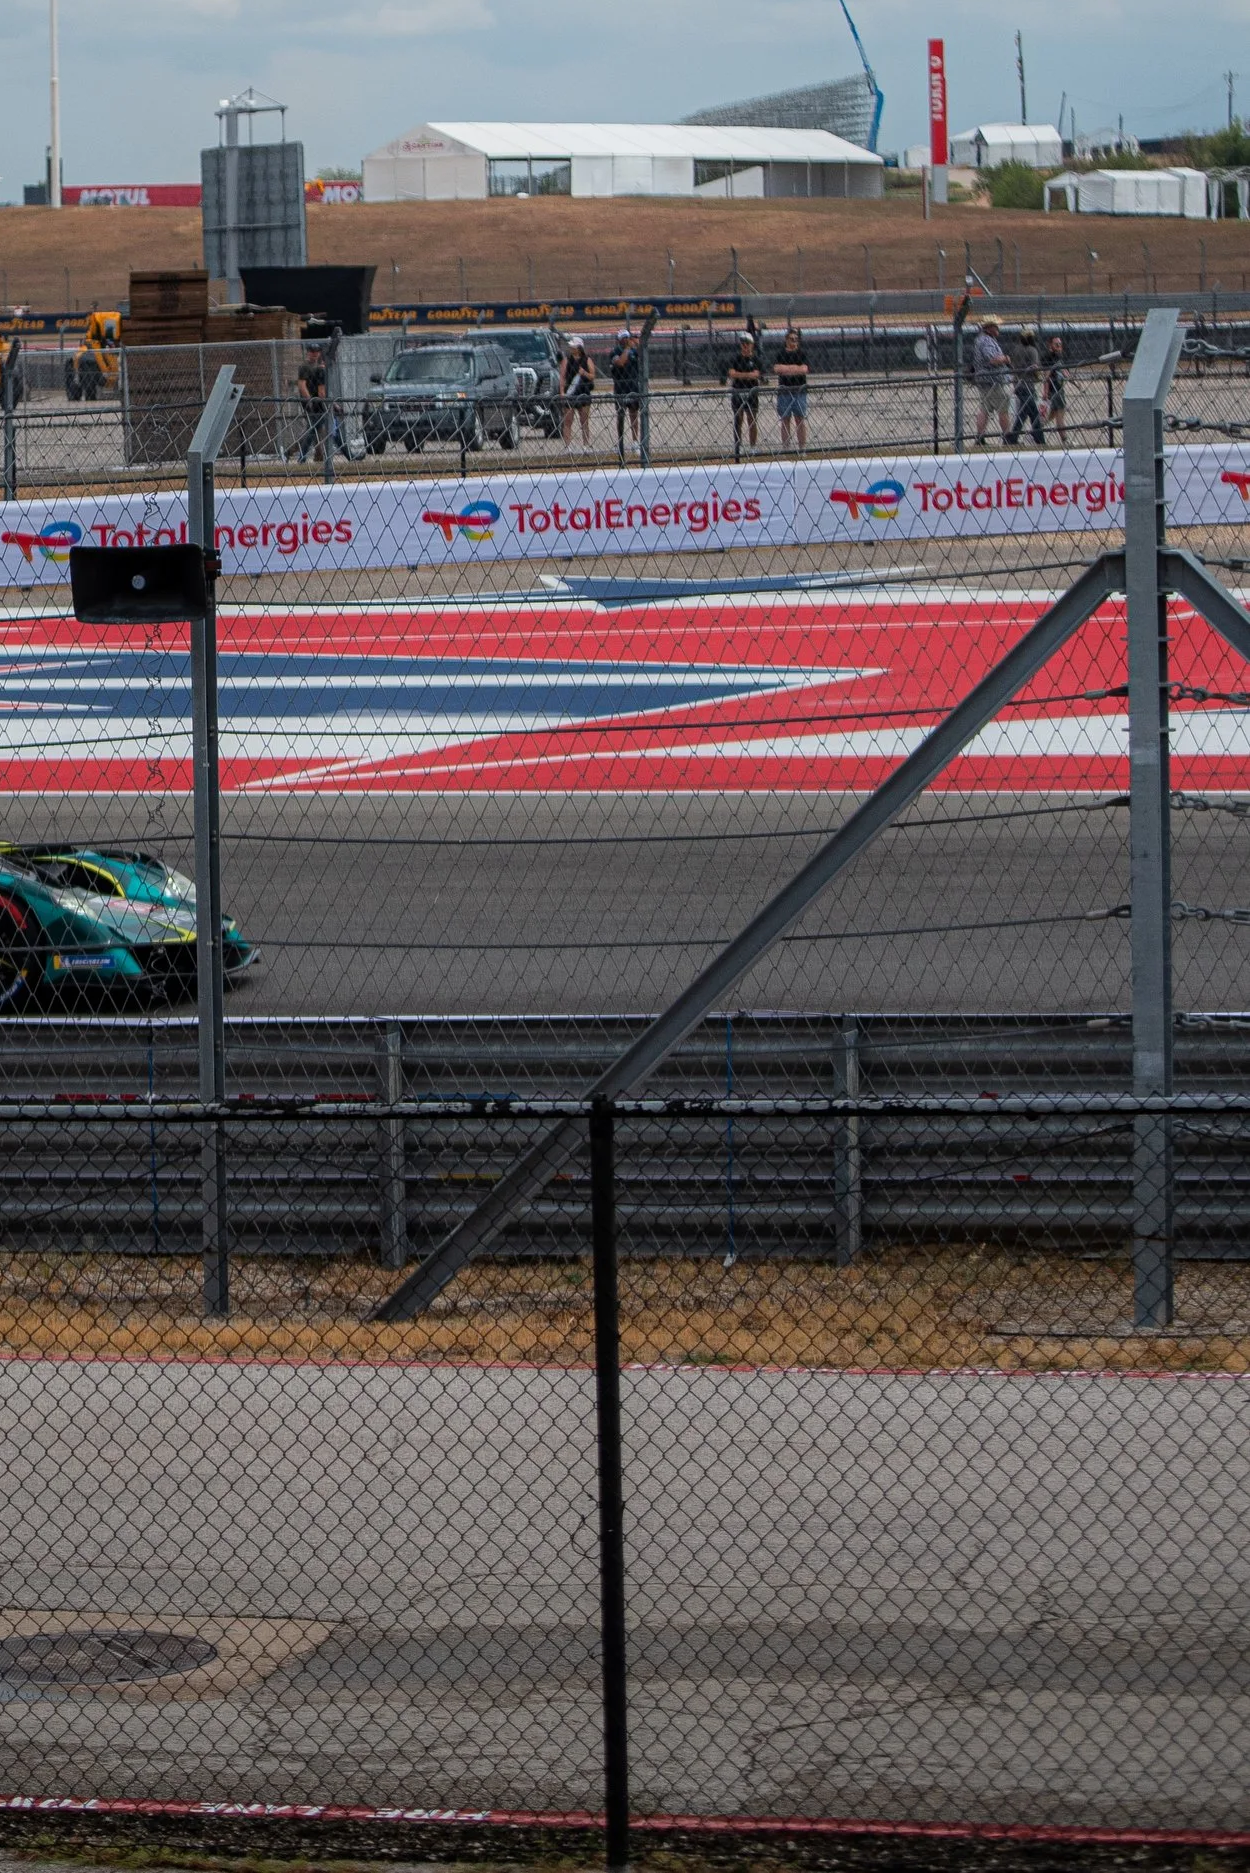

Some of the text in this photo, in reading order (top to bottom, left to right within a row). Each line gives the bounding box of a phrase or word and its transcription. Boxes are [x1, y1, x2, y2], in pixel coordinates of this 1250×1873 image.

[79, 187, 150, 206] MOTUL
[322, 184, 364, 204] MO
[912, 472, 1125, 514] TotalEnergi
[508, 491, 762, 534] TotalEnergies
[90, 511, 354, 555] Totalnergies
[365, 1806, 492, 1821] FIRE
